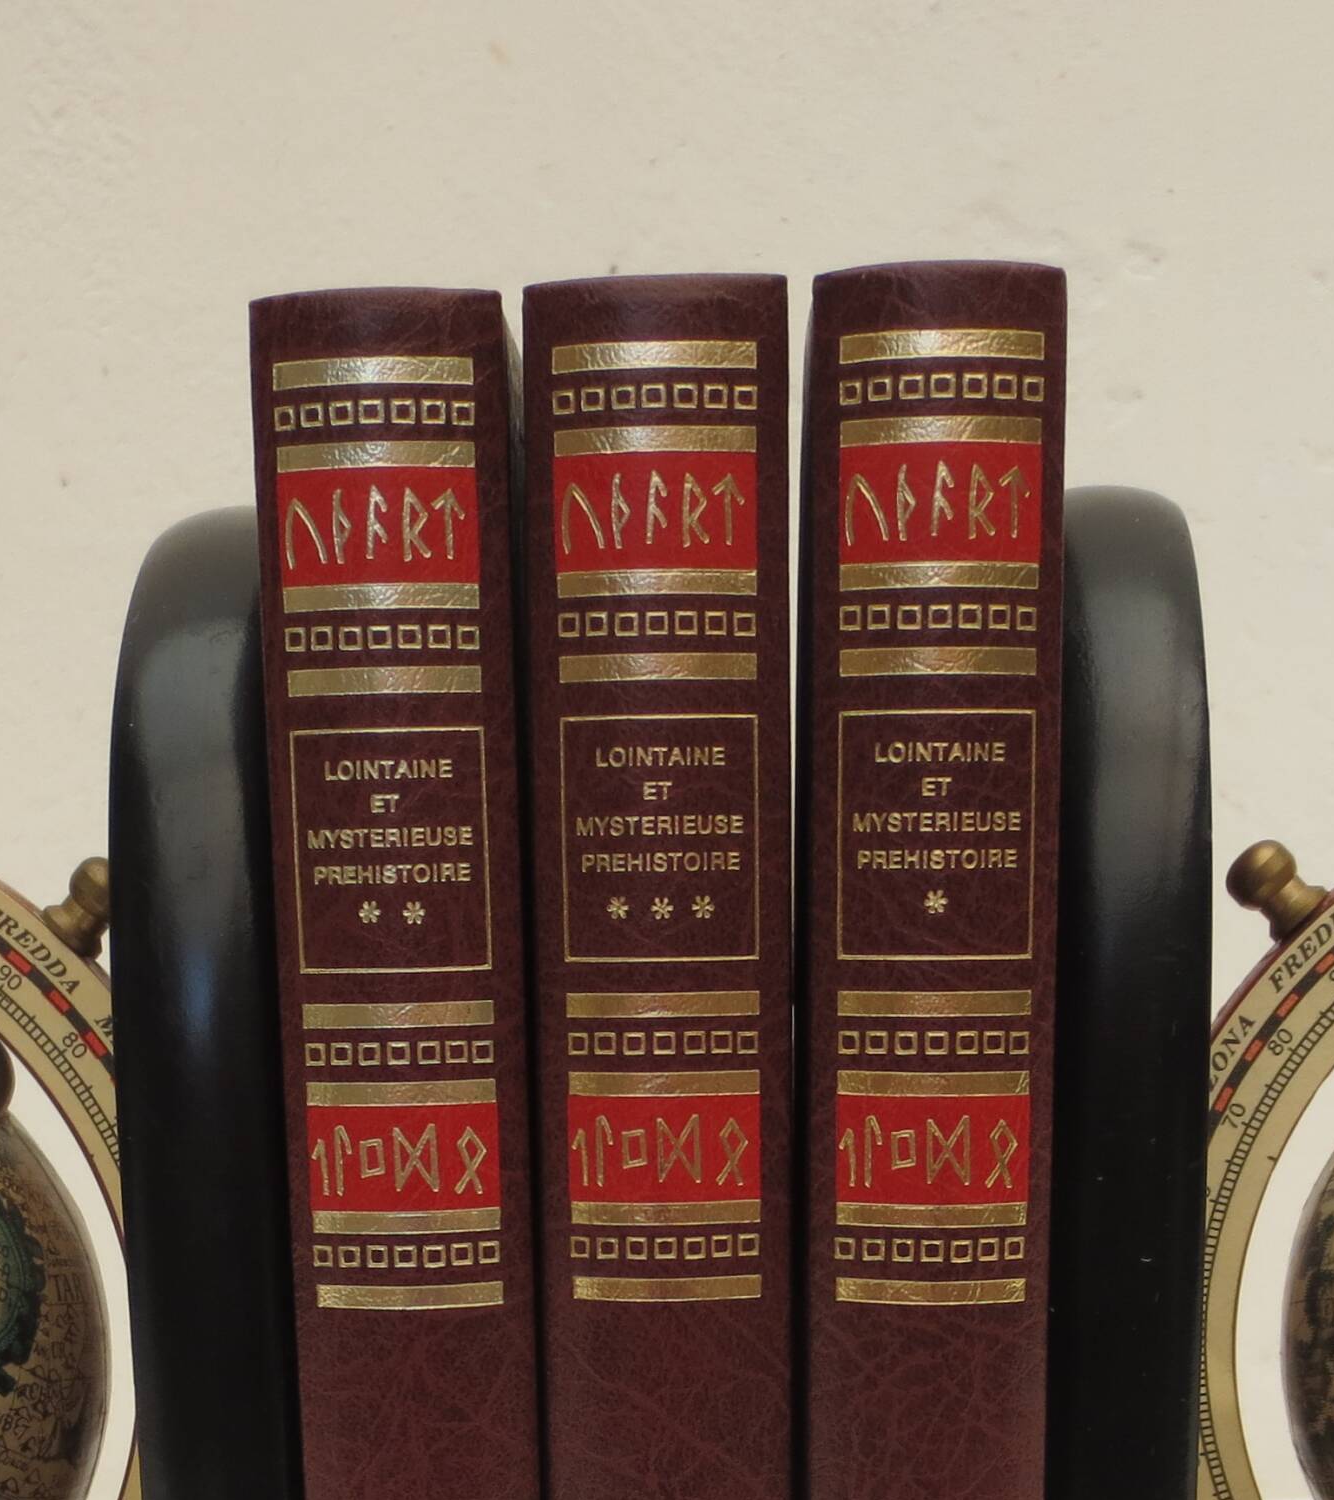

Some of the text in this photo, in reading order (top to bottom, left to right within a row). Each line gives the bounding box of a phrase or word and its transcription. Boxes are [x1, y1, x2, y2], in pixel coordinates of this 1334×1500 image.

[595, 746, 726, 769] LOINTAINE
[874, 741, 1006, 763] LOINTAINE
[324, 758, 453, 781] LOINTAINE
[643, 782, 672, 800] ET
[921, 777, 952, 796] ET
[369, 794, 400, 813] ET
[576, 813, 745, 837] MYSTERIEUSE
[852, 811, 1022, 833] MYSTERIEUSE
[307, 827, 474, 850] MYSTERIEUSE
[581, 850, 741, 873] PREHISTOIRE
[857, 847, 1018, 870] PREHISTOIRE
[314, 862, 472, 886] PREHISTOIRE
[62, 1032, 88, 1059] 80
[1267, 1028, 1293, 1057] 80
[1220, 1102, 1247, 1131] 70
